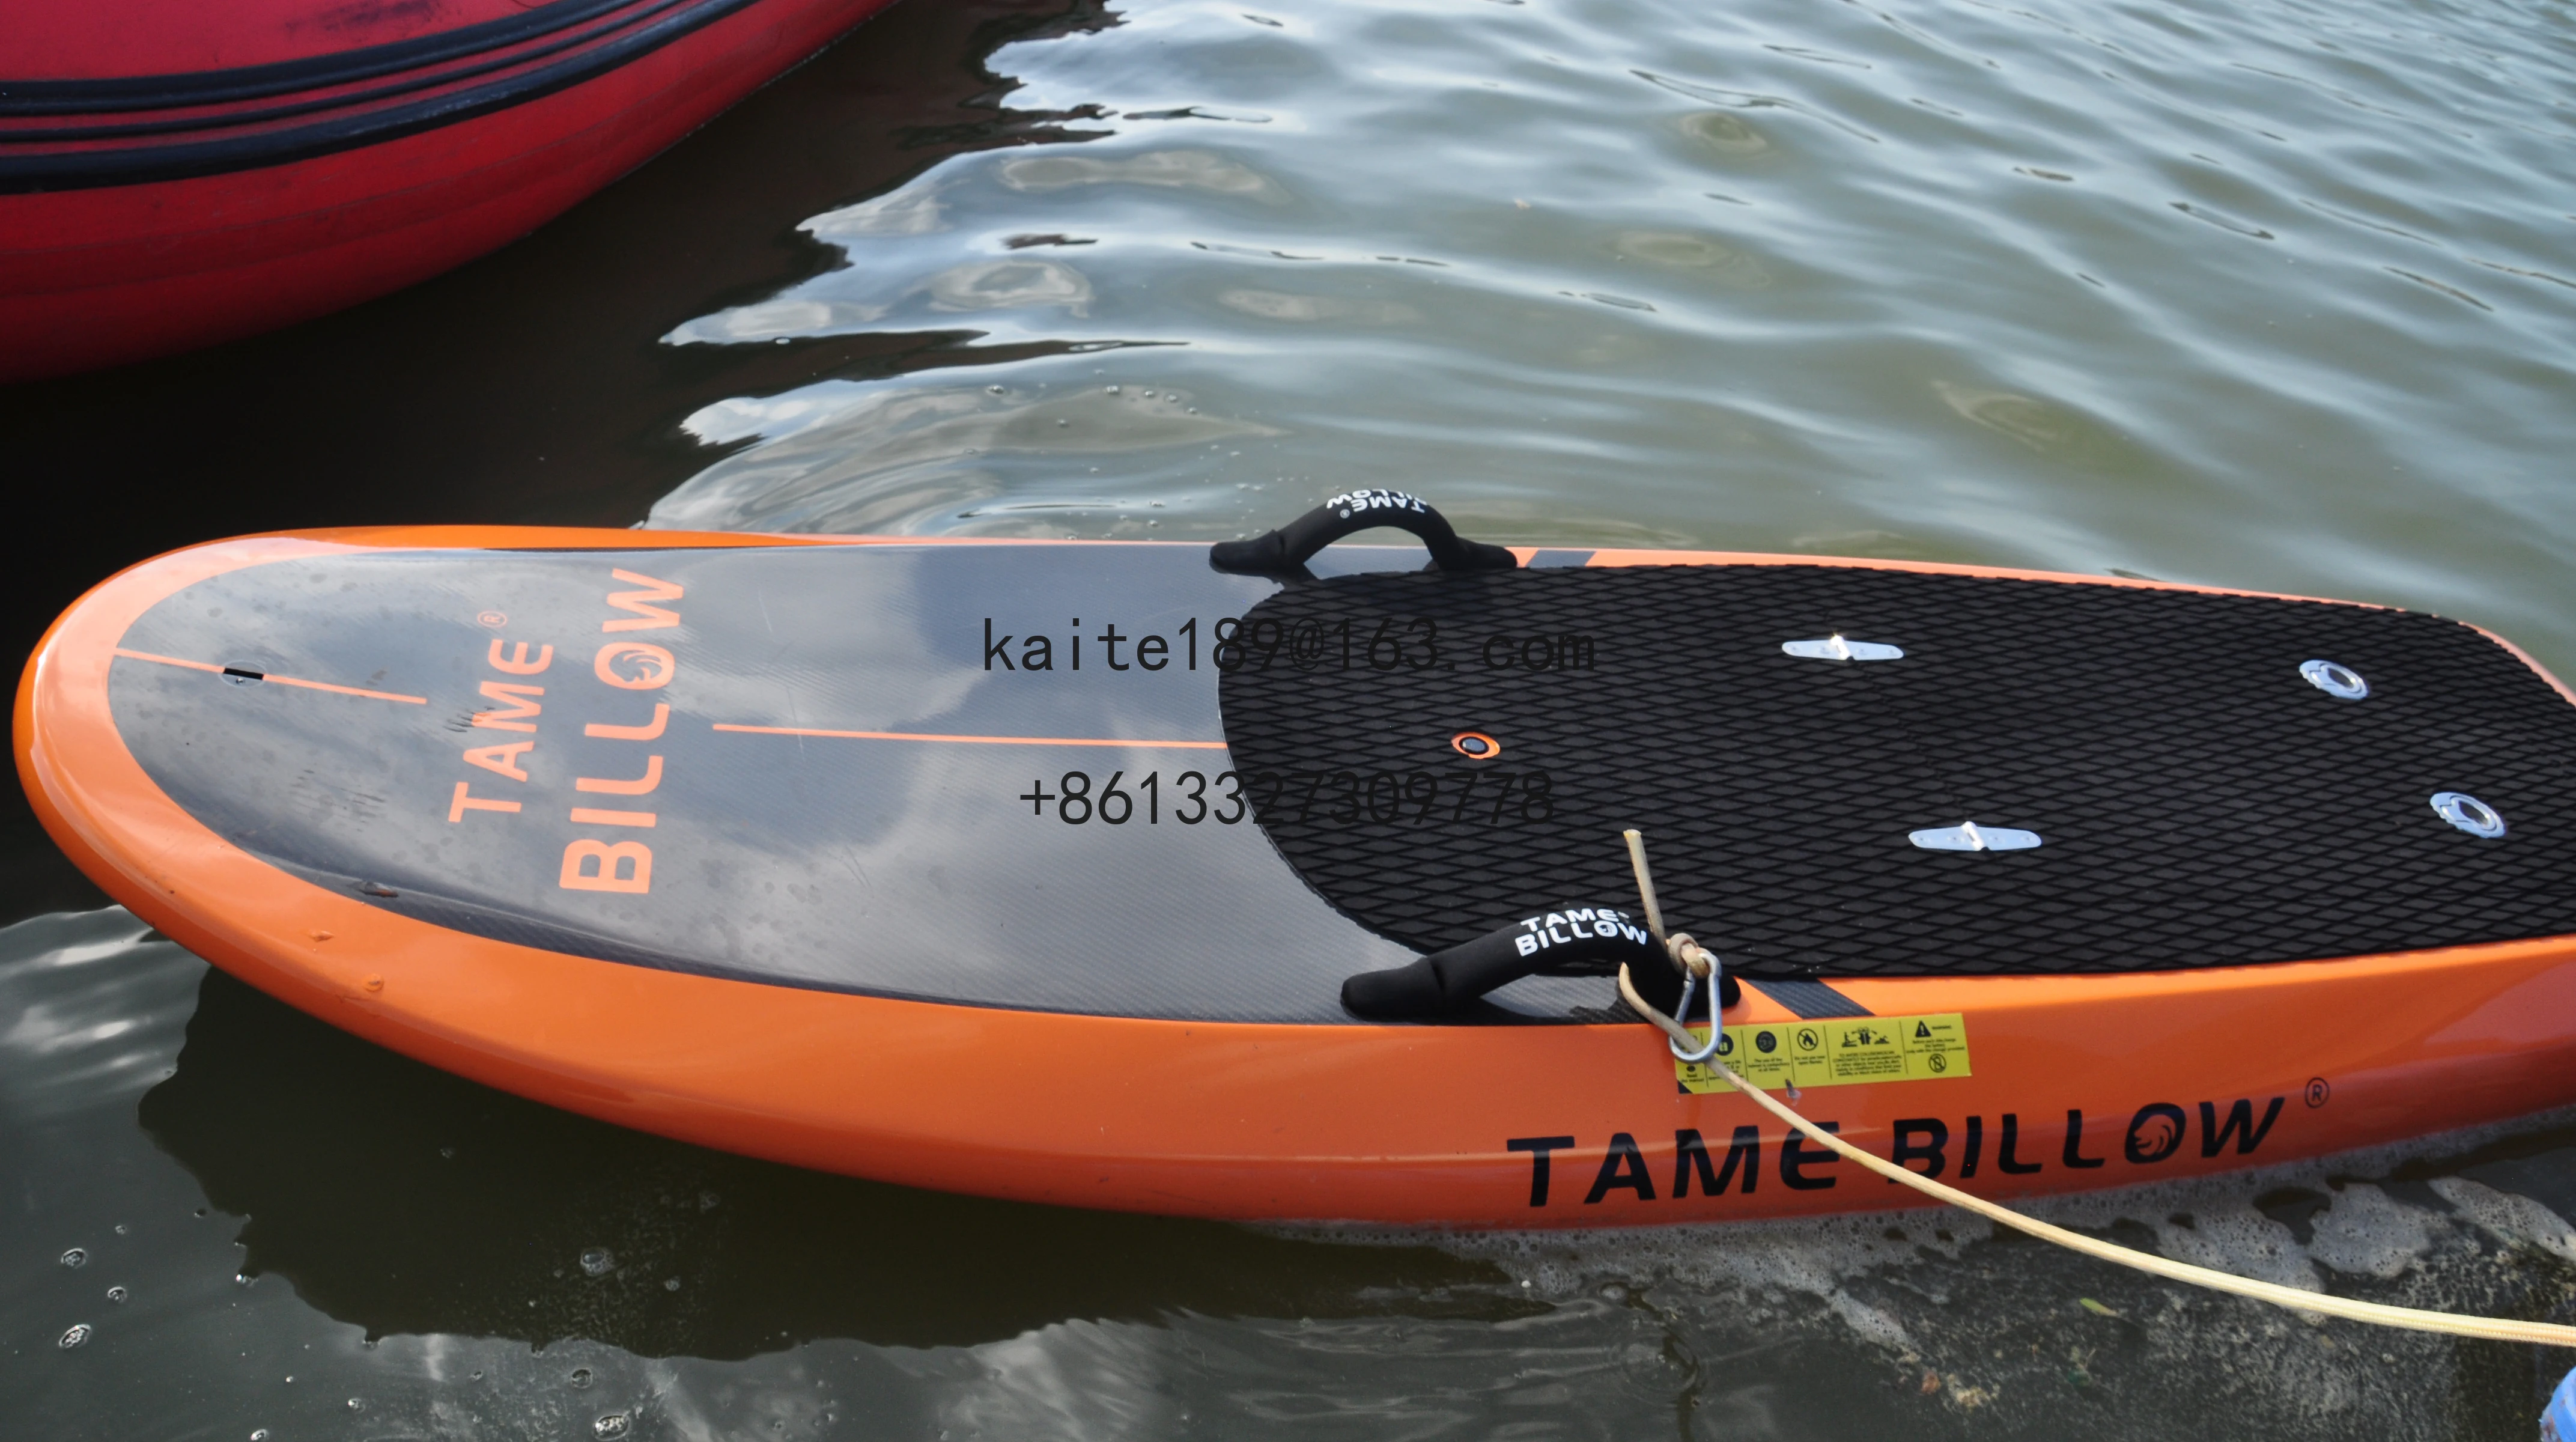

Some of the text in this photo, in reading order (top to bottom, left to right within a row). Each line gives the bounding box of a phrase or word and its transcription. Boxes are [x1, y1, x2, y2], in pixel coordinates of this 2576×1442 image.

[448, 638, 553, 823] TAME
[559, 568, 684, 894] BILLOW
[1515, 920, 1647, 957] BILLOW
[1520, 908, 1620, 932] TAME
[1506, 1097, 2285, 1207] TAME BILLOW
